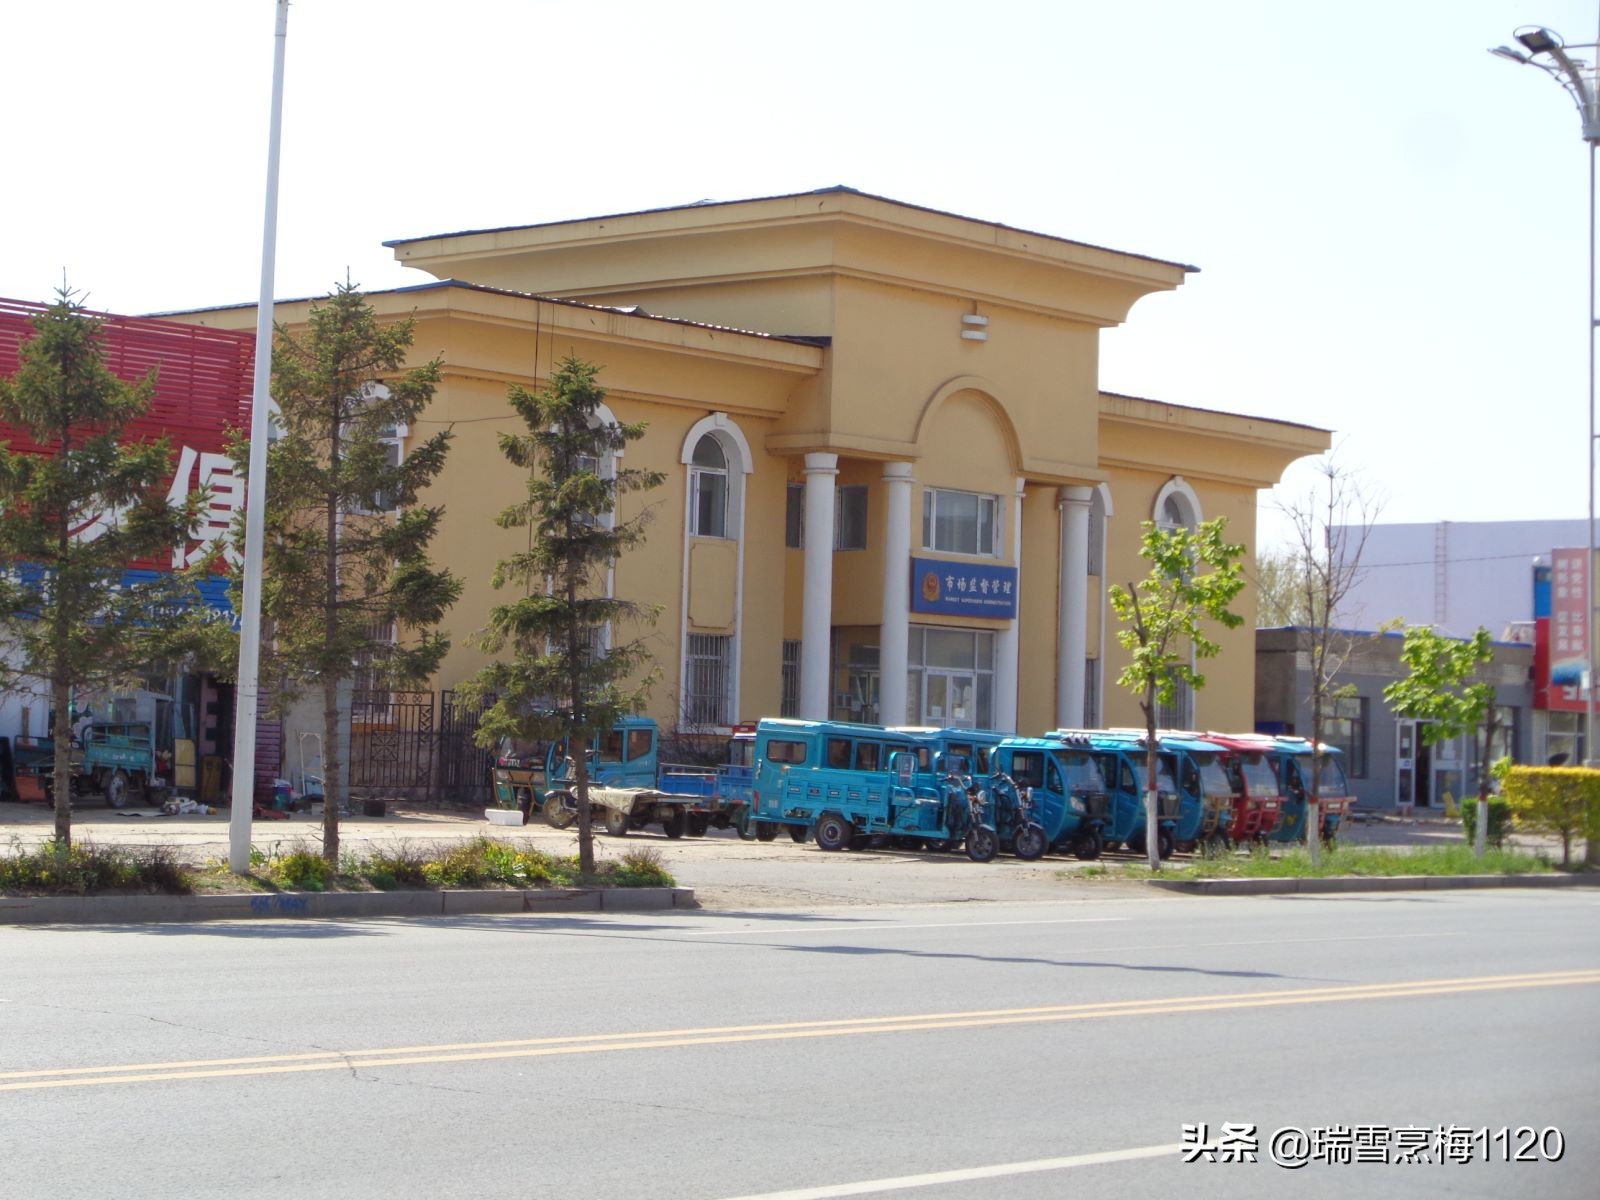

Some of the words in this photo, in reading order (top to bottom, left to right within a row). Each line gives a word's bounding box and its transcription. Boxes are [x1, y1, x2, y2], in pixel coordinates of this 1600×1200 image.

[945, 575, 1012, 594] 市场监督管理
